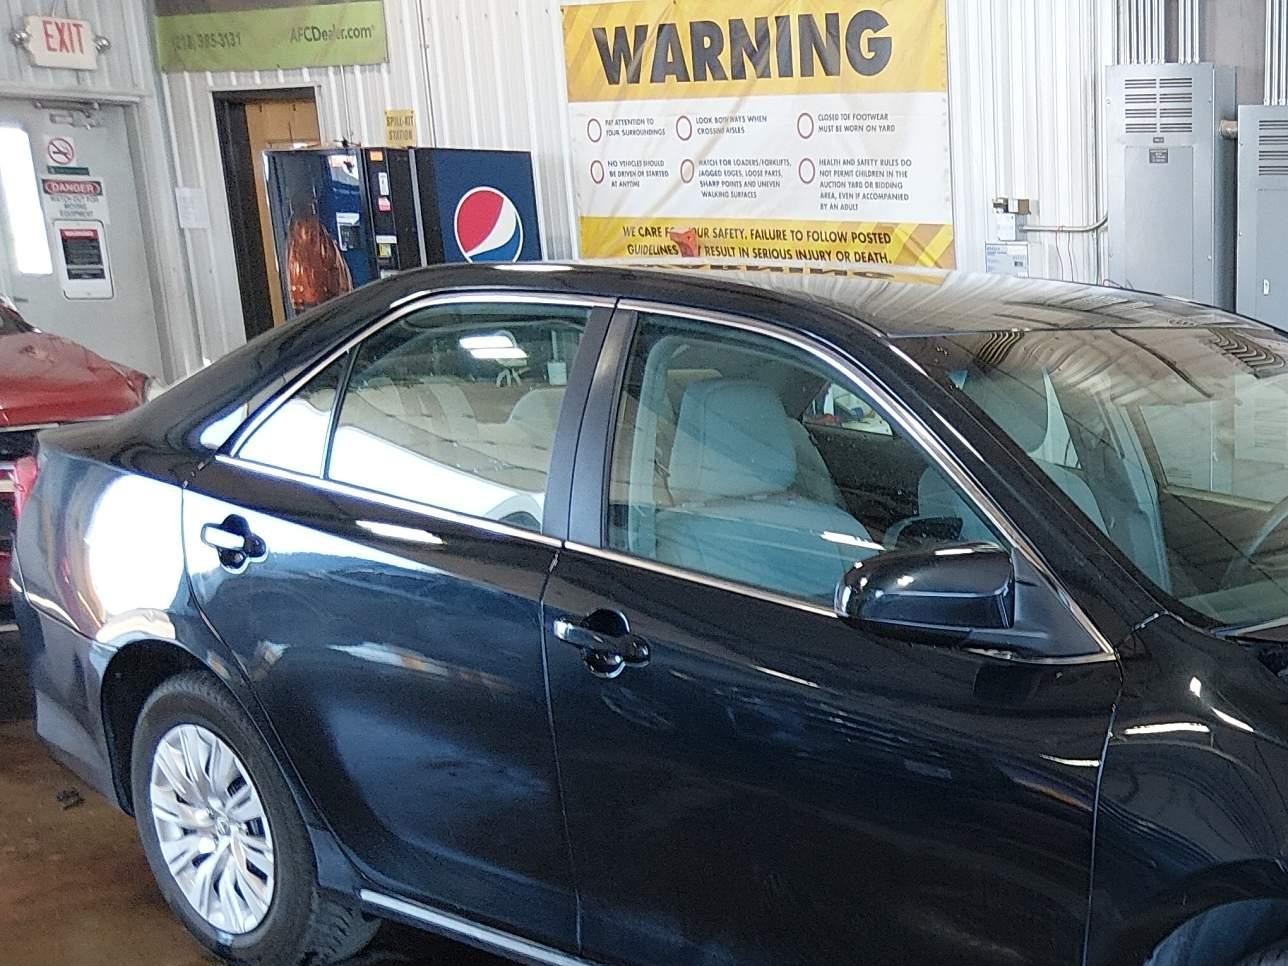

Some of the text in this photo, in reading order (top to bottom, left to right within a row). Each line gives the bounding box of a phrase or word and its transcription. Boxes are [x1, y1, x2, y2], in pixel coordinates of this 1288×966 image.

[42, 20, 84, 55] EXIT
[592, 9, 893, 86] WARNING
[714, 116, 729, 124] BOTH
[730, 115, 746, 123] WAYS
[747, 114, 767, 122] WHEN
[817, 113, 889, 121] CLOSED TOE FOOTWEAR
[615, 118, 645, 126] ATTENTION
[621, 128, 666, 136] SURROUNDINGS
[697, 126, 745, 135] CROSSING AISLES
[389, 129, 413, 141] STATION
[900, 159, 912, 167] DO
[855, 170, 885, 178] CHILDREN
[886, 170, 894, 178] IN
[895, 170, 908, 178] THE
[52, 182, 95, 193] DANGER
[700, 180, 720, 188] SHARP
[848, 181, 863, 189] YARD
[864, 181, 874, 189] OR
[875, 181, 903, 189] BIDDING
[702, 190, 729, 198] WALKING
[820, 192, 909, 200] AREA, EVEN IF ACCOMPANIED
[623, 226, 636, 237] WE
[638, 226, 662, 238] CARE
[712, 227, 748, 240] SAFETY.
[750, 228, 788, 241] FAILURE
[790, 229, 804, 241] TO
[806, 230, 848, 243] FOLLOW
[851, 231, 892, 244] POSTED
[627, 244, 679, 256] GUIDELINES
[704, 245, 736, 257] RESULT
[739, 247, 749, 258] IN
[752, 248, 793, 260] SERIOUS
[795, 249, 832, 261] INJURY
[835, 251, 852, 262] OR
[854, 252, 893, 264] DEATH.
